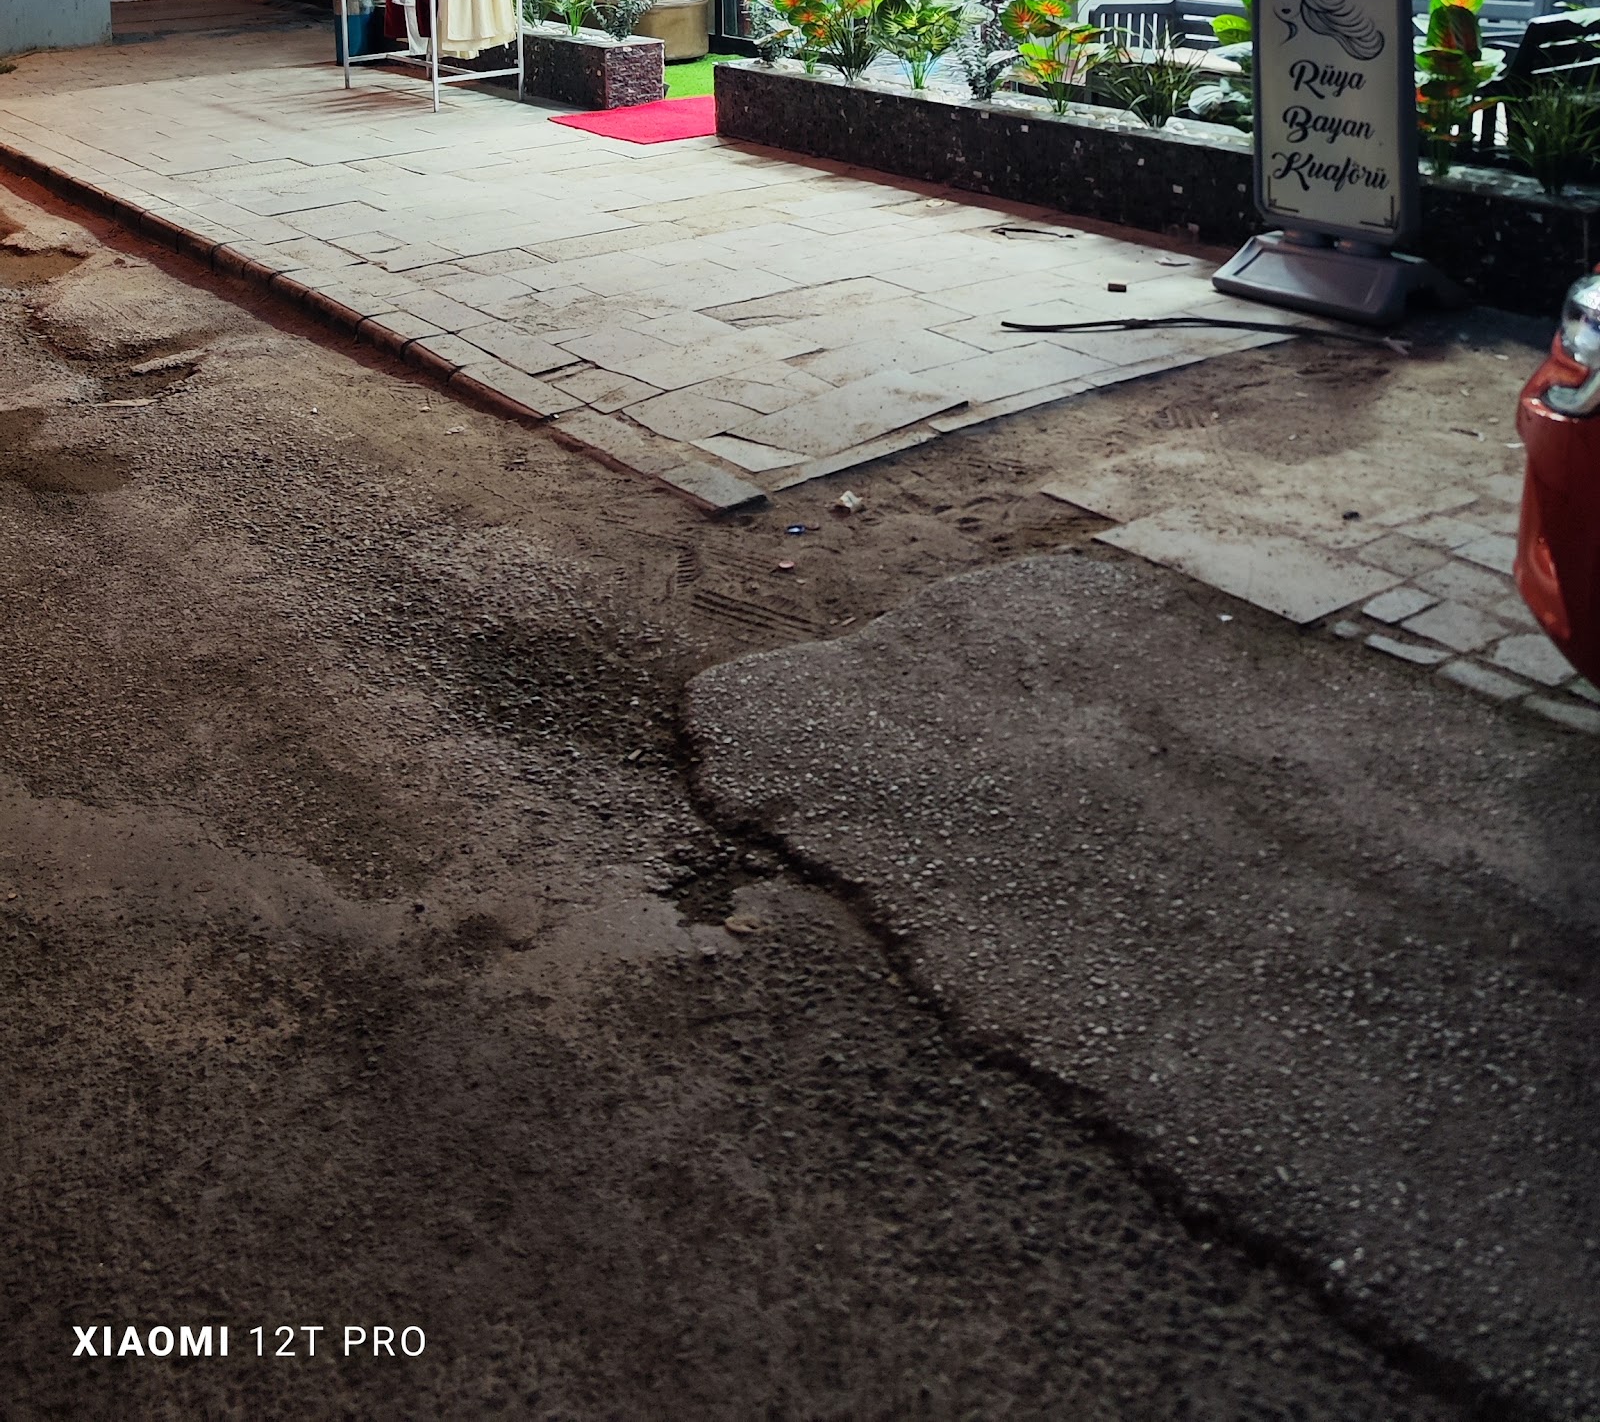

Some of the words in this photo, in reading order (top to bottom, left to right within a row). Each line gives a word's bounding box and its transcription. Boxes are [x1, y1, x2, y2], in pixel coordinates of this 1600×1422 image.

[1288, 59, 1367, 100] Rüya
[1281, 105, 1375, 145] Bayan
[1271, 151, 1391, 193] Kuaförü
